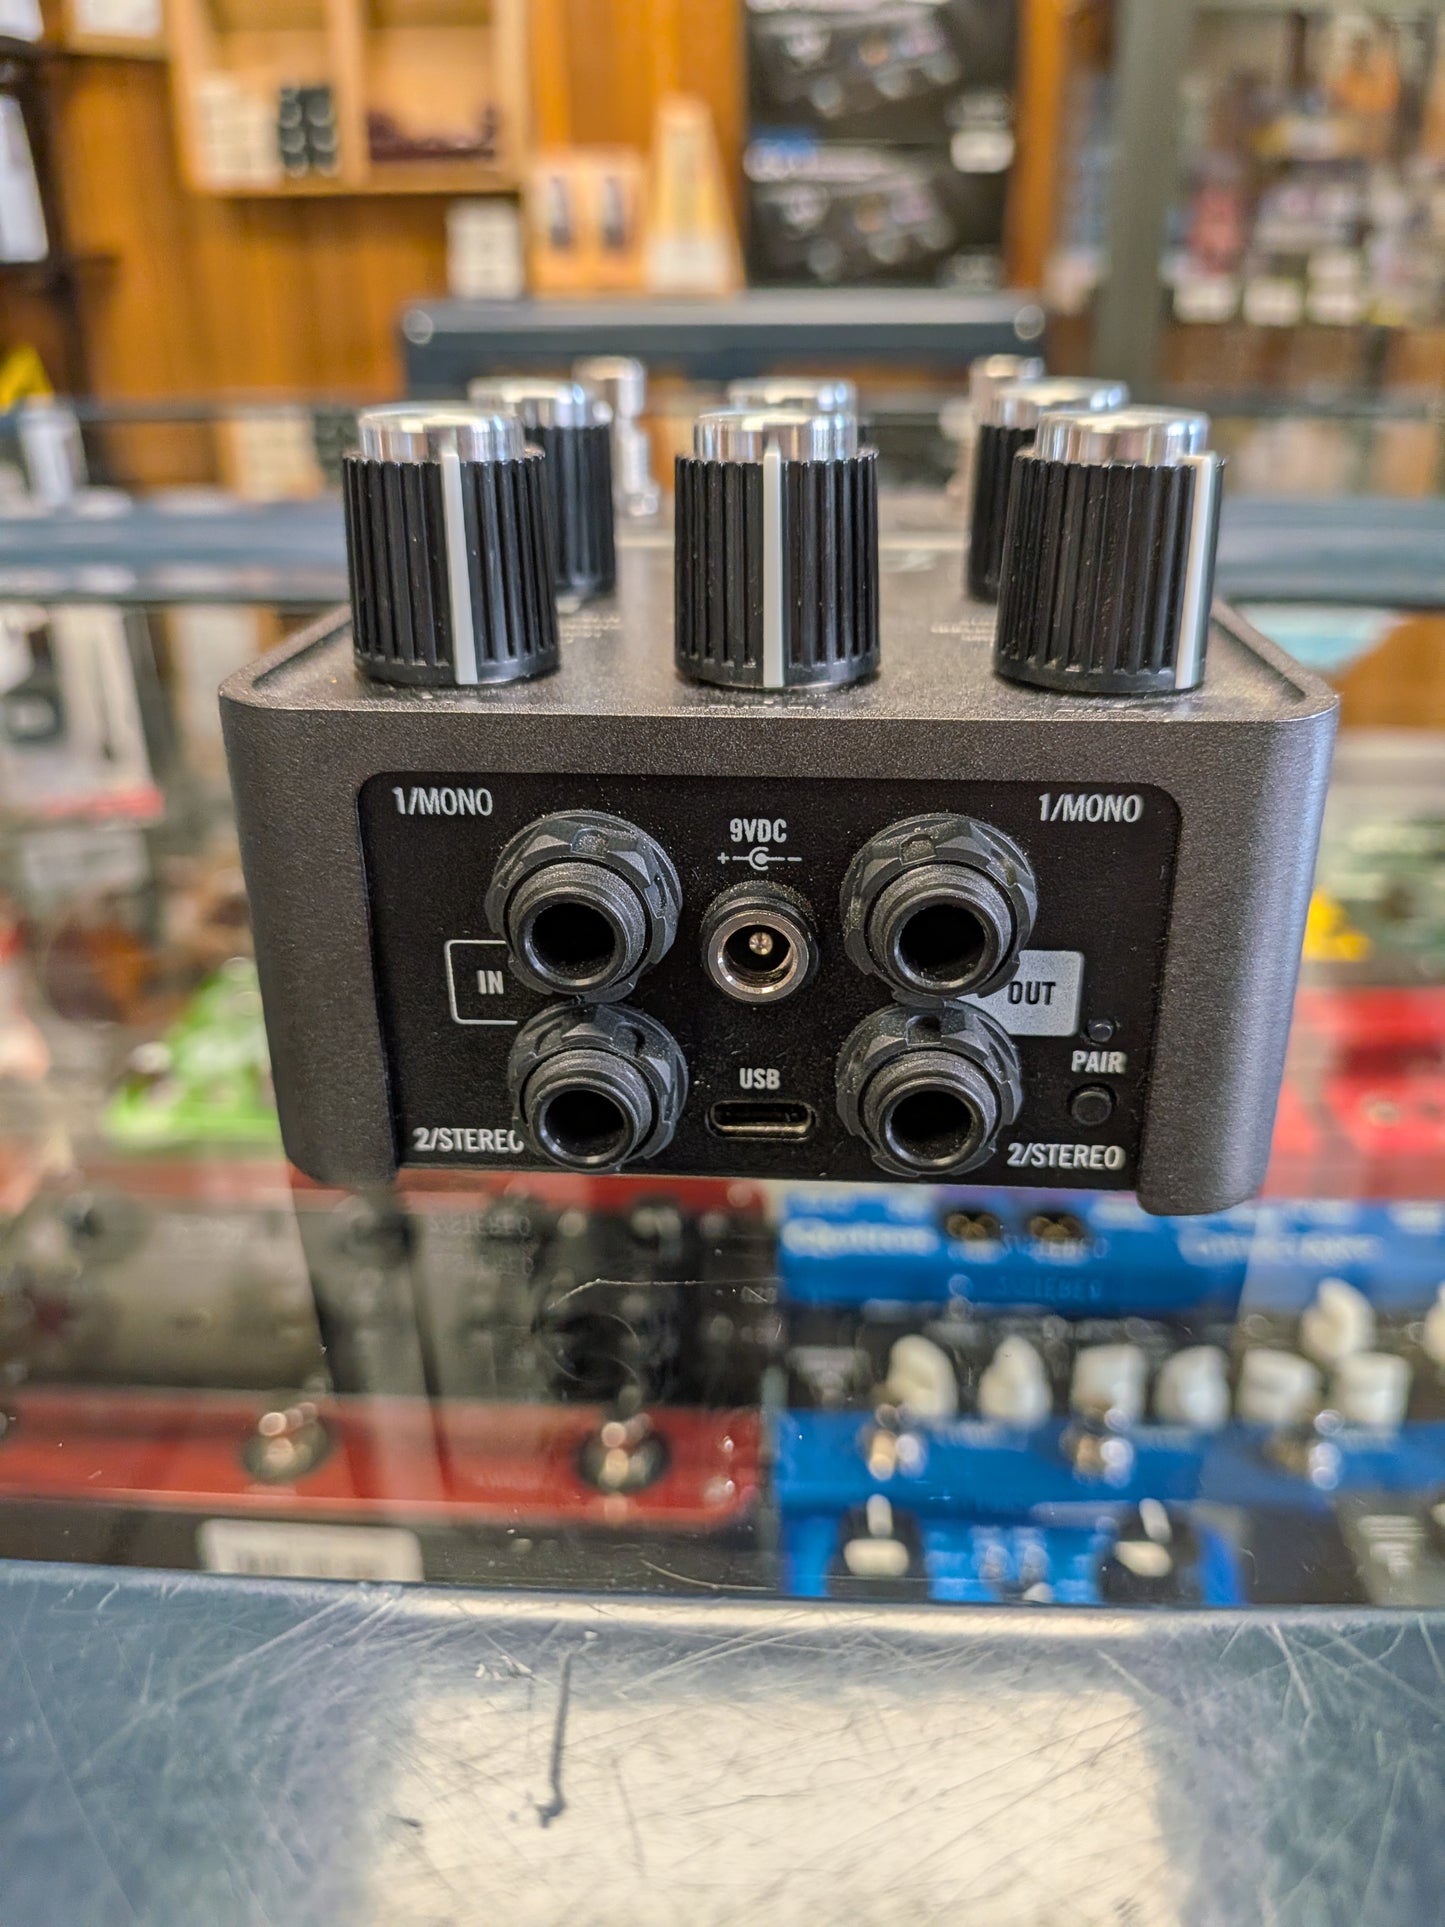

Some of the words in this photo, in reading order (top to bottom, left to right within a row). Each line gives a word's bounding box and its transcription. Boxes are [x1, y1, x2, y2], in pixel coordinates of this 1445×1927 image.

[393, 787, 494, 816] 1/MONO
[1039, 793, 1143, 823] 1/MONO
[730, 818, 787, 843] 9VDC
[477, 970, 504, 994] IN
[1008, 980, 1056, 1005] OUT
[1071, 1050, 1127, 1074] PAIR
[739, 1068, 780, 1090] USB
[1007, 1142, 1125, 1170] 2/STEREO
